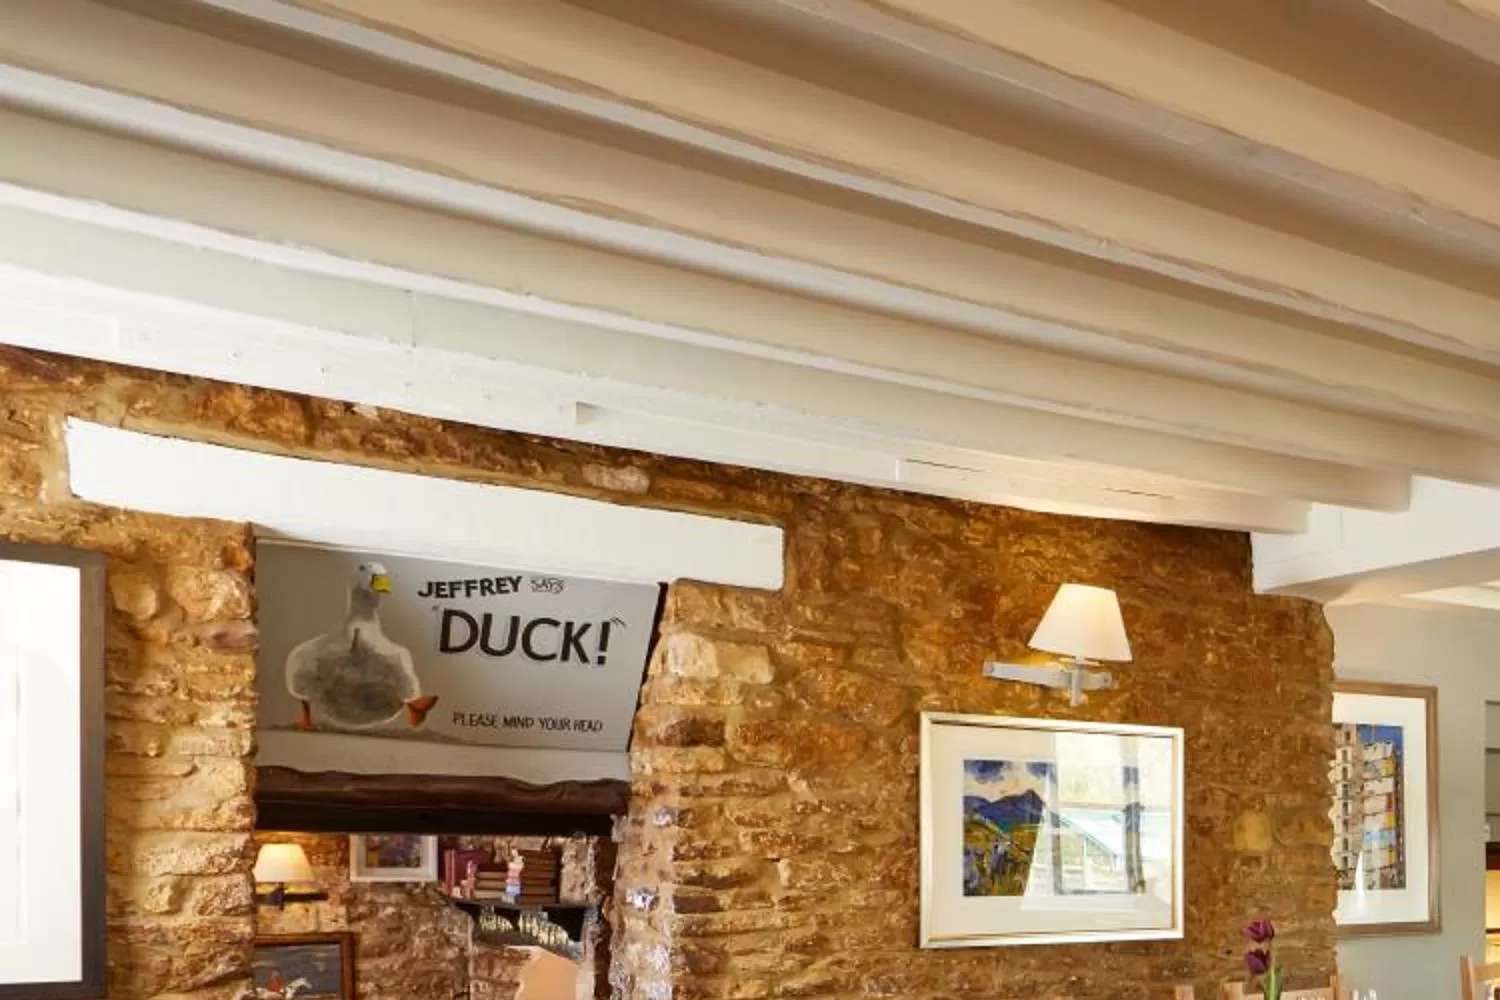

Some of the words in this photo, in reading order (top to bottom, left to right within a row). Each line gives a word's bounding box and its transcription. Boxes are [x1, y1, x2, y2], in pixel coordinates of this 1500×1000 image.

[417, 575, 523, 599] JEFFREY
[529, 577, 566, 595] SAYS
[452, 711, 498, 729] PLEASE
[502, 715, 535, 730] MIND
[537, 717, 572, 732] YOUR
[573, 719, 605, 733] HEAD
